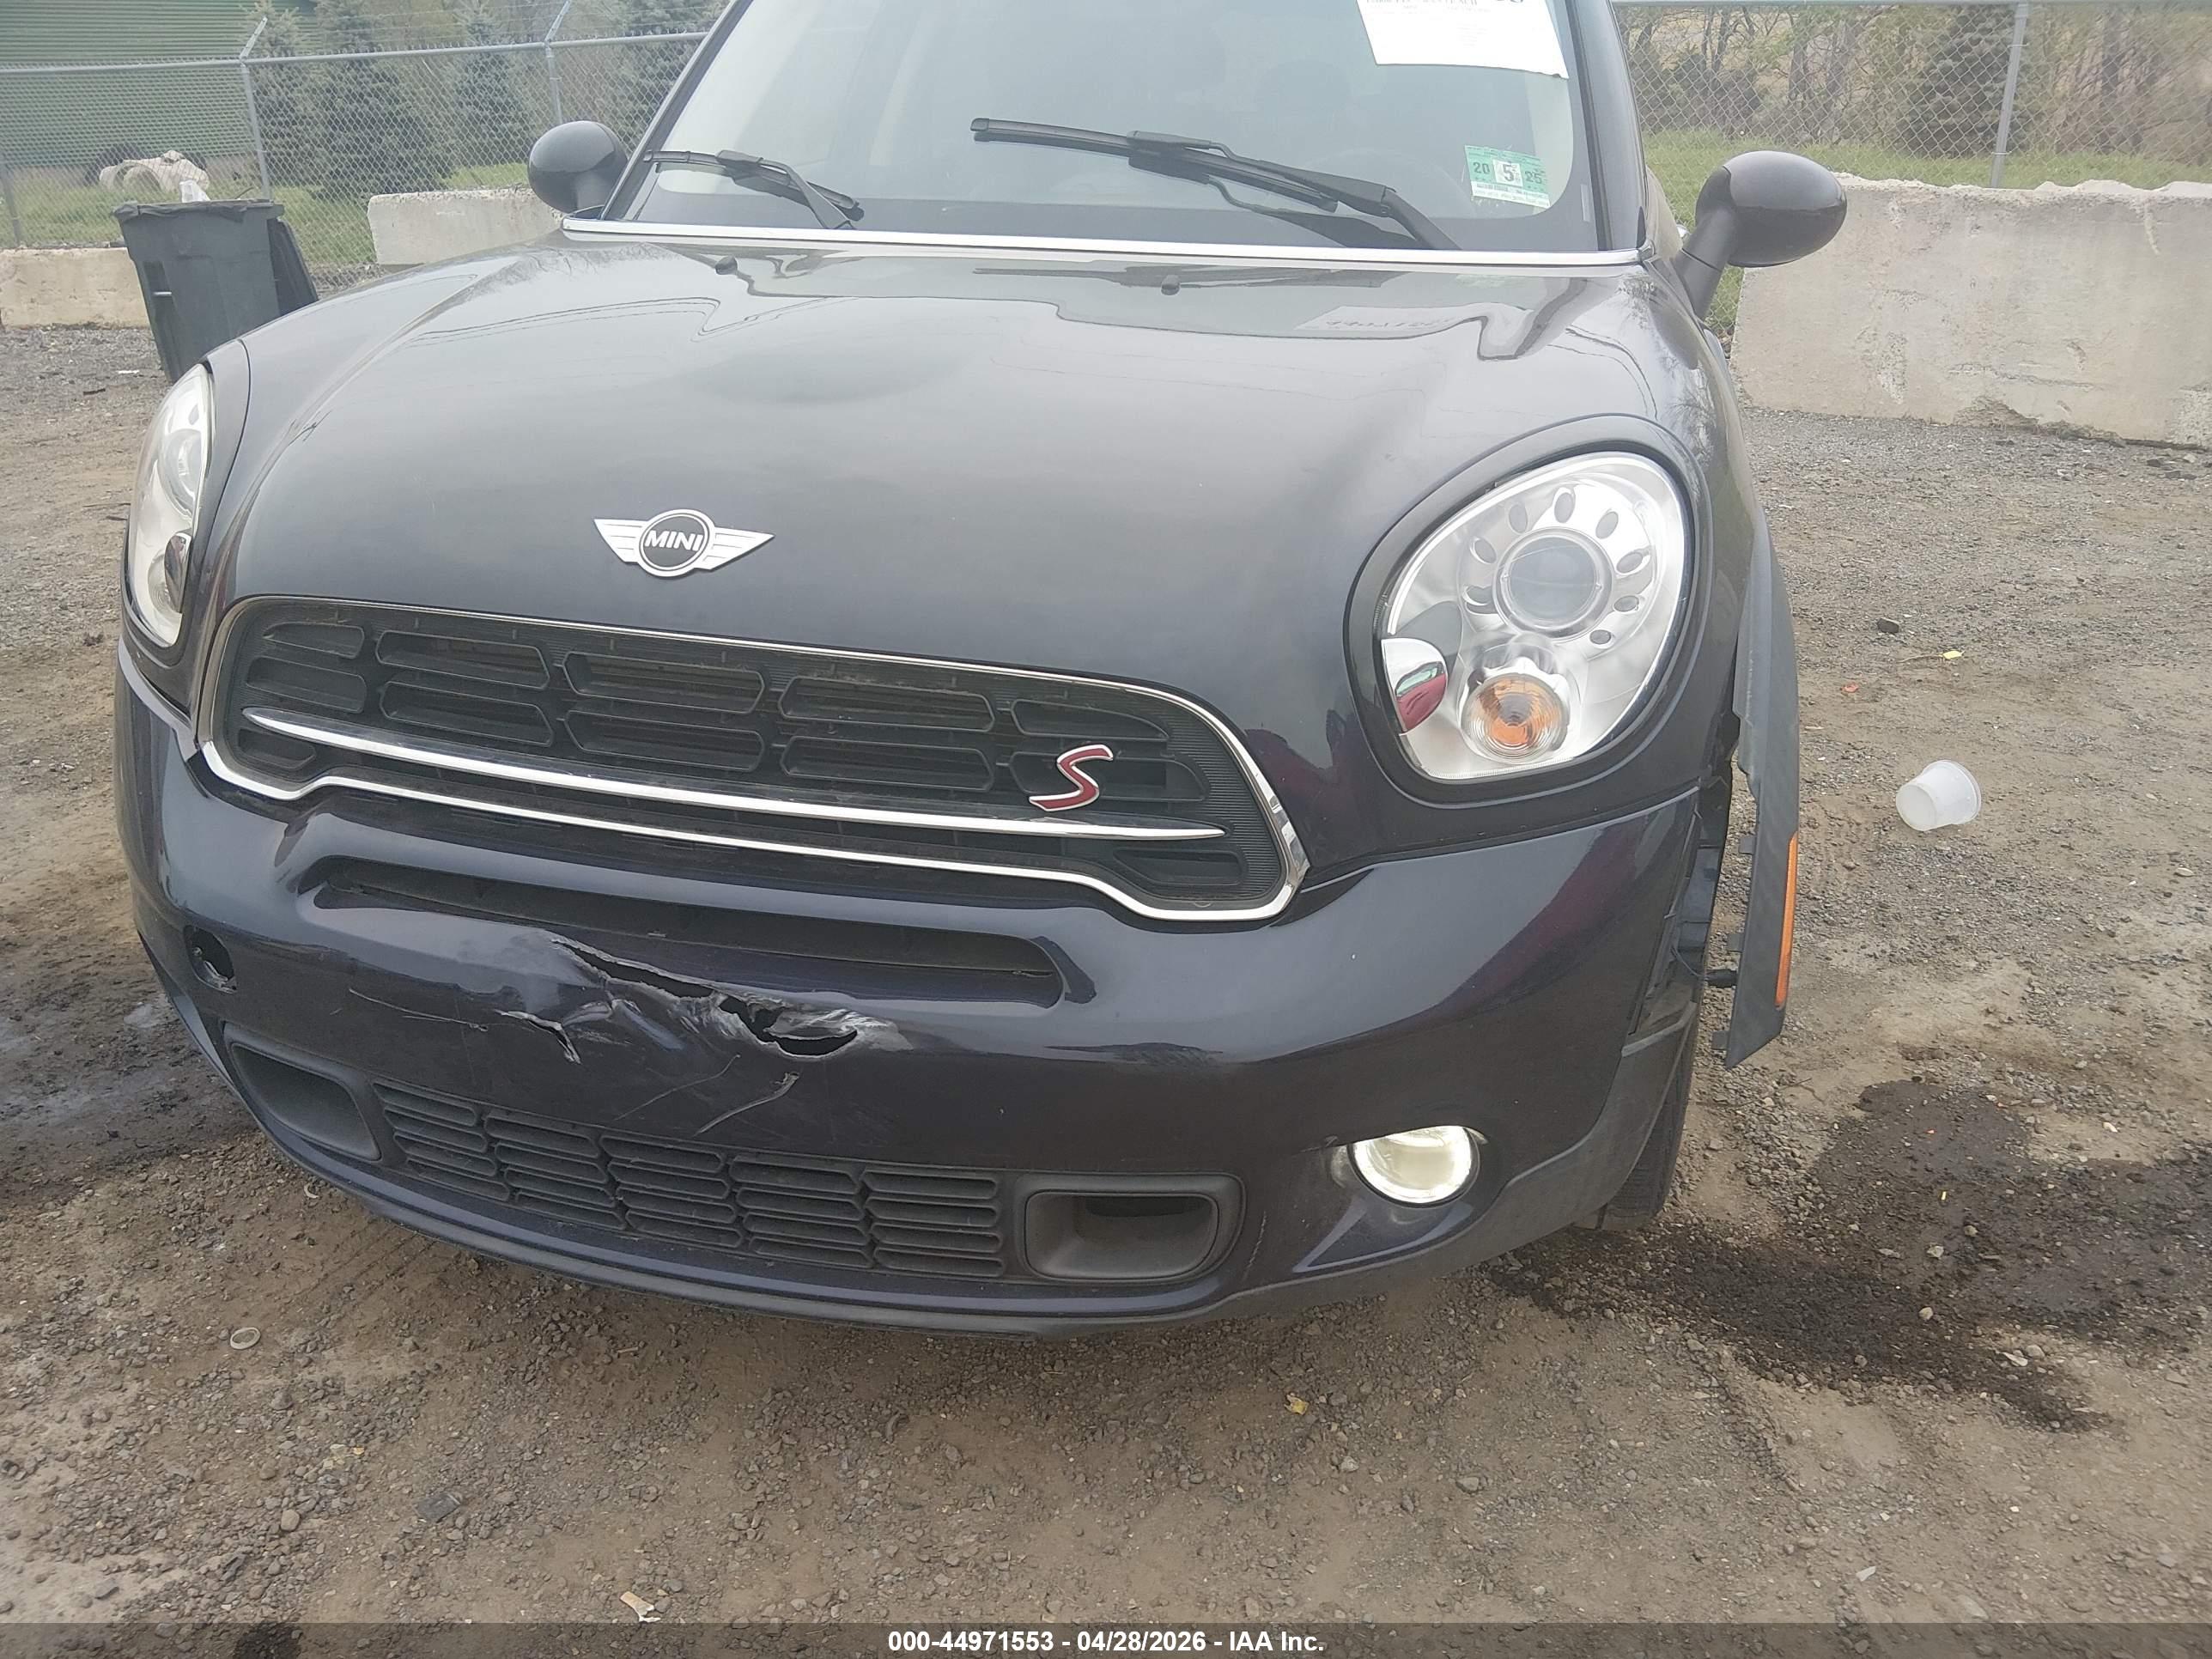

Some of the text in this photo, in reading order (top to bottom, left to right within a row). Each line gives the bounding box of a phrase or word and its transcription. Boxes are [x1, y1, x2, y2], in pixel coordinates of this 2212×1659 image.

[1473, 161, 1491, 174] 20
[1503, 163, 1515, 182] 5
[644, 529, 704, 551] MINI
[1029, 744, 1114, 812] S
